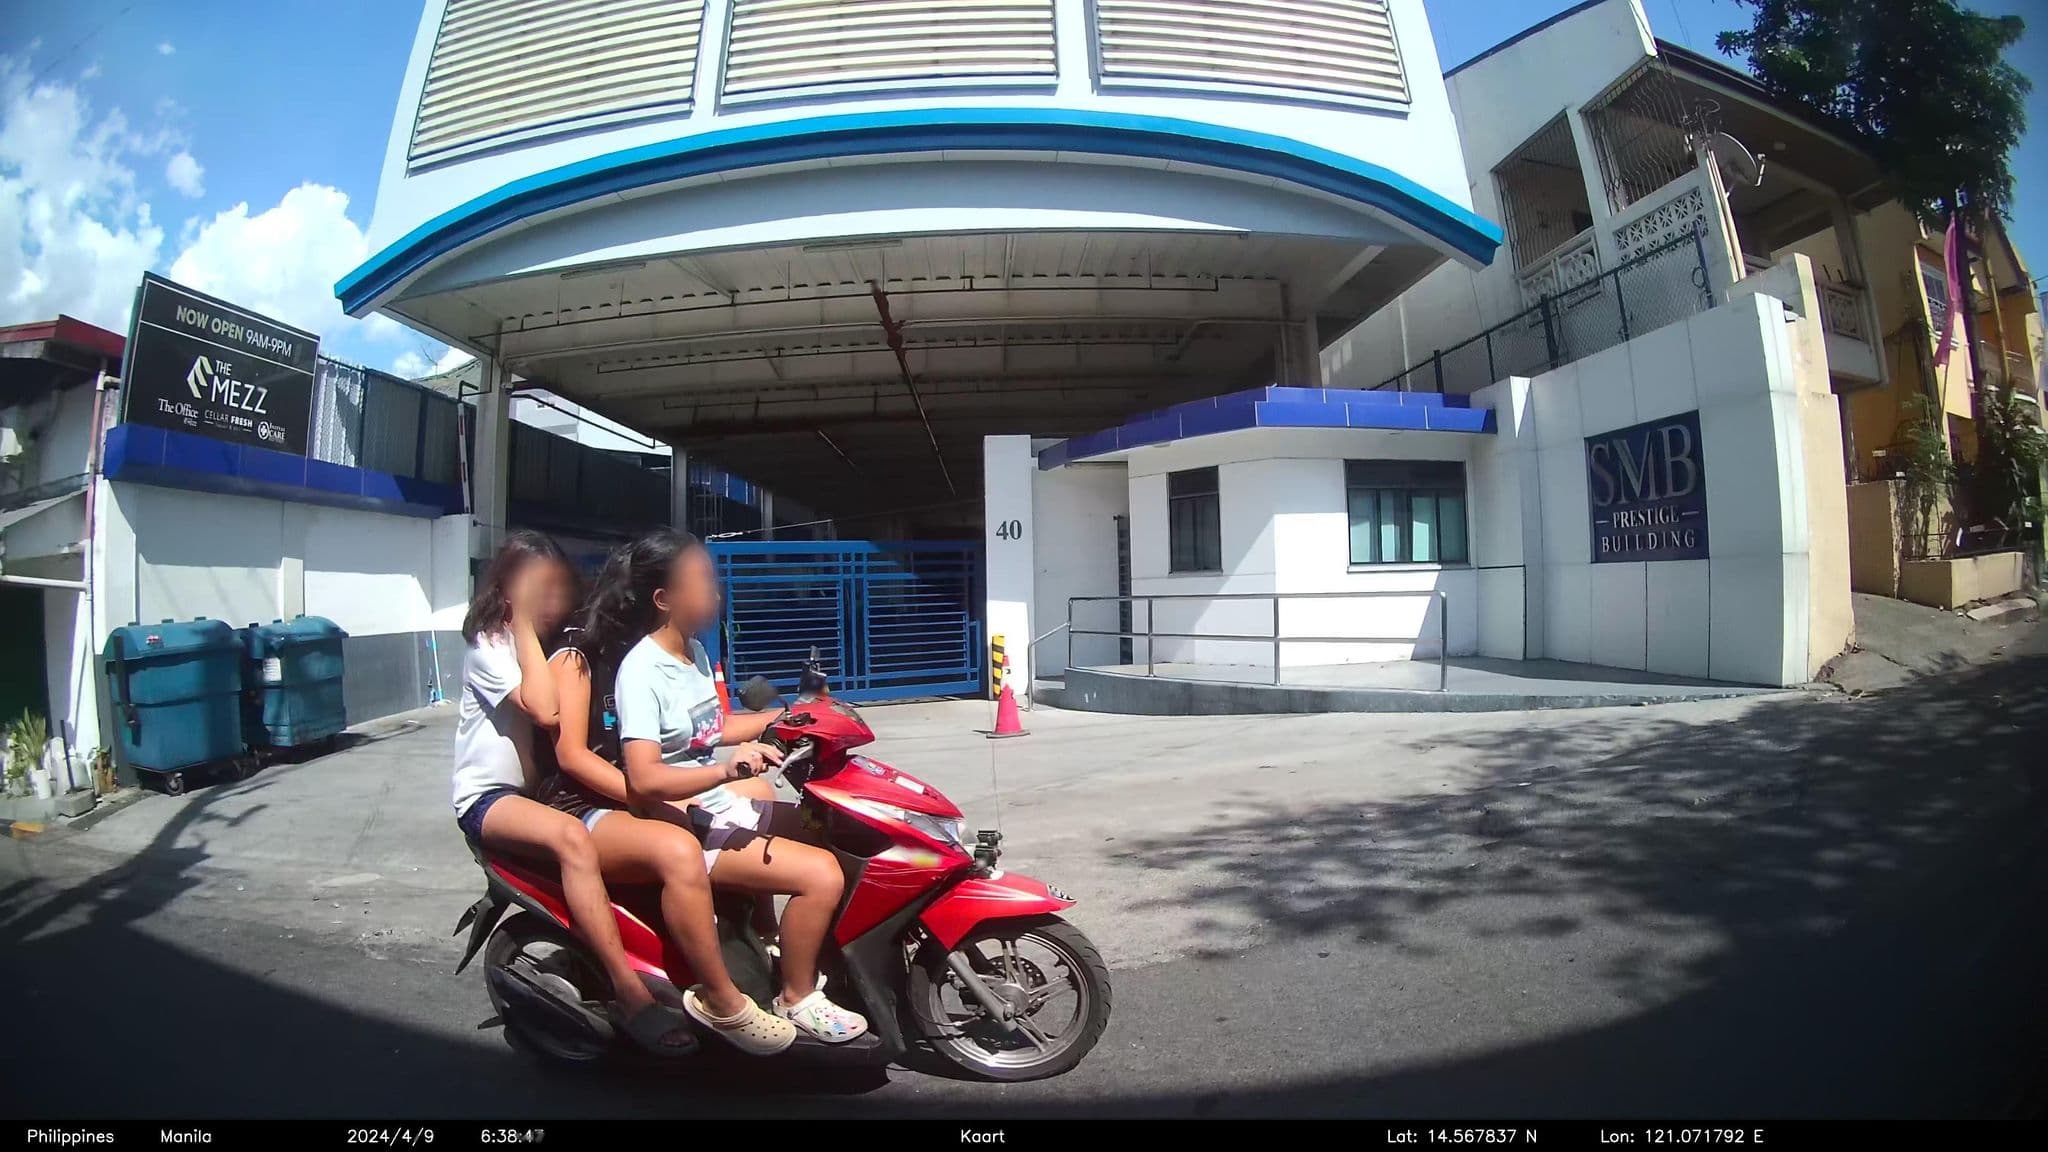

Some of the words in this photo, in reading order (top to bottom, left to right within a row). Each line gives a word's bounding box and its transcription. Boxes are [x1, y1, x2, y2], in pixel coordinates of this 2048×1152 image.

[176, 305, 209, 329] NOW
[211, 317, 244, 341] OPEN
[246, 329, 292, 357] 9AM-9PM
[216, 360, 232, 376] THE
[211, 375, 268, 414] MEZZ
[158, 398, 174, 413] The
[175, 402, 199, 418] Office
[204, 409, 229, 423] CELLAR
[230, 415, 253, 428] FRESH
[1590, 425, 1697, 506] SMB
[1613, 505, 1680, 529] PRESTIGE
[996, 519, 1022, 540] 40
[1602, 529, 1696, 553] BUILDING
